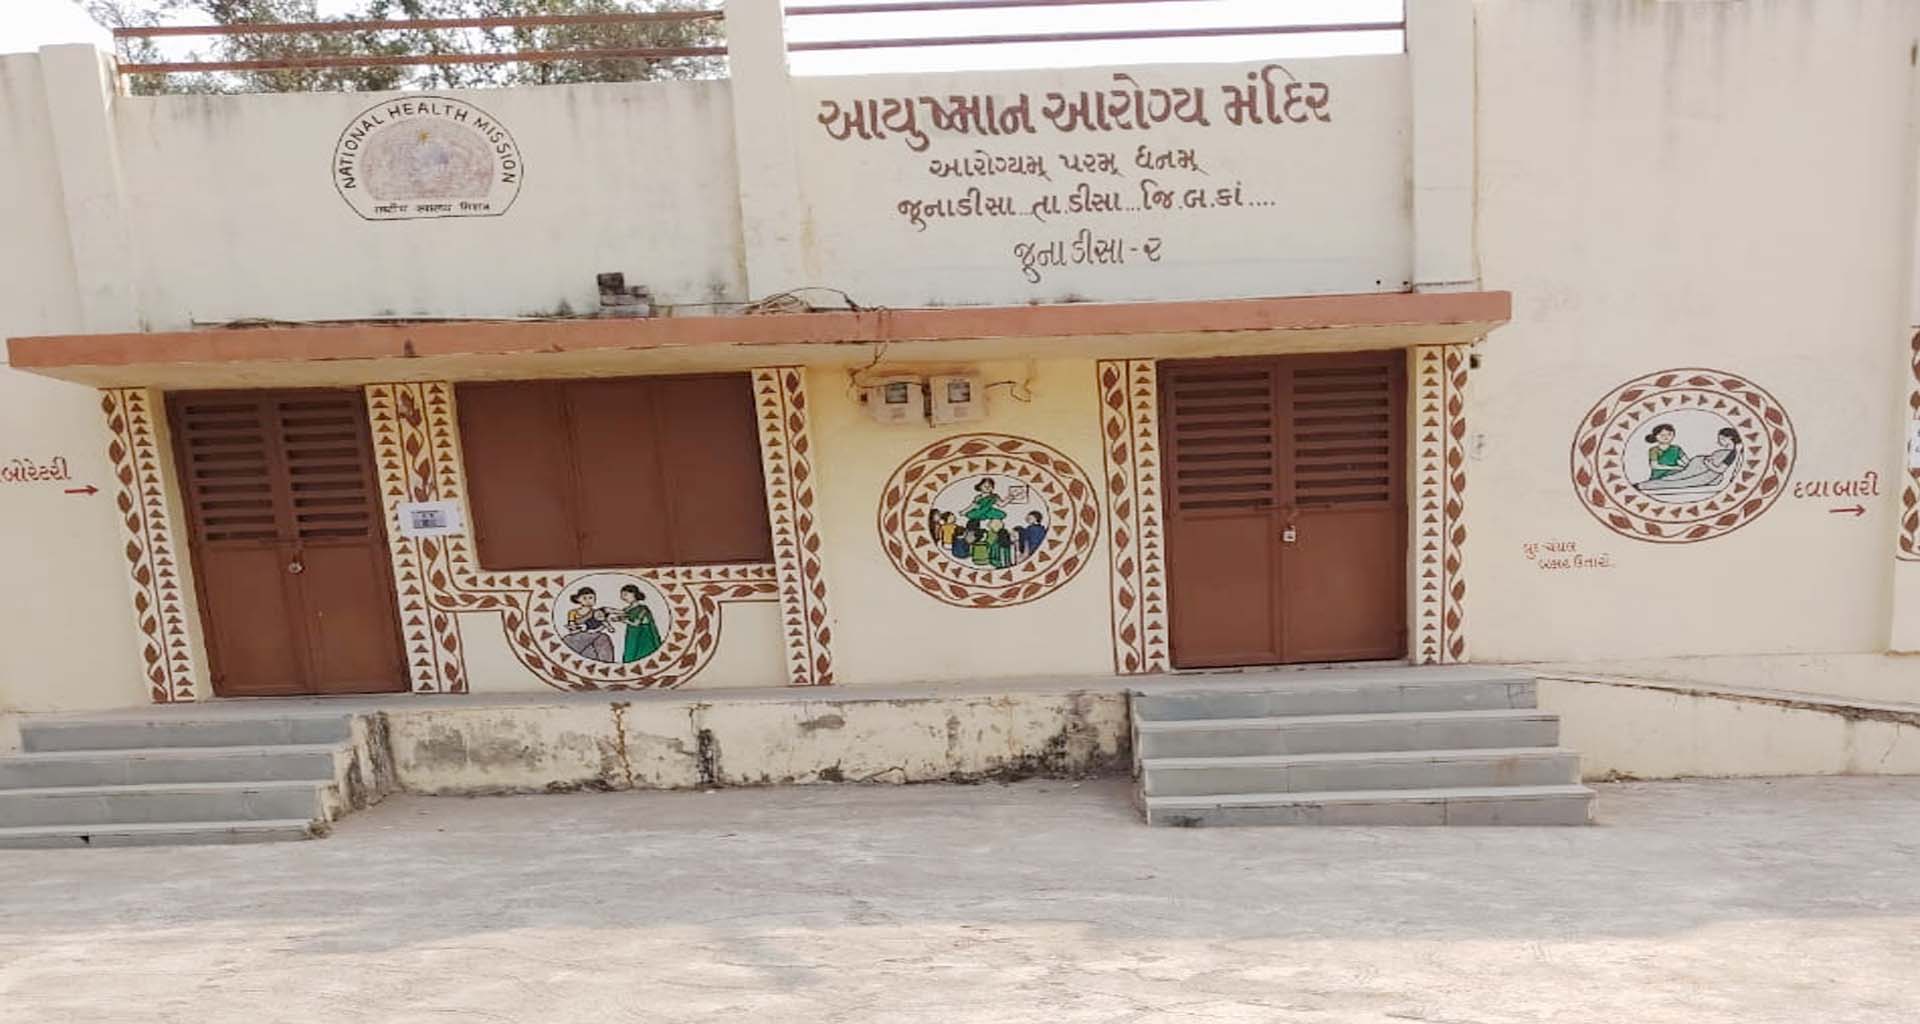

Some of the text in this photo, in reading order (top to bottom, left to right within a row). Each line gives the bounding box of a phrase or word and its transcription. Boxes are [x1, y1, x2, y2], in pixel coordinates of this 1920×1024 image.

[338, 102, 518, 189] NATIONAL HEALTH MISSION
[817, 63, 1332, 152] આયુષ્માન આરોગ્ય મંદિર
[0, 456, 72, 482] બોરેટરી
